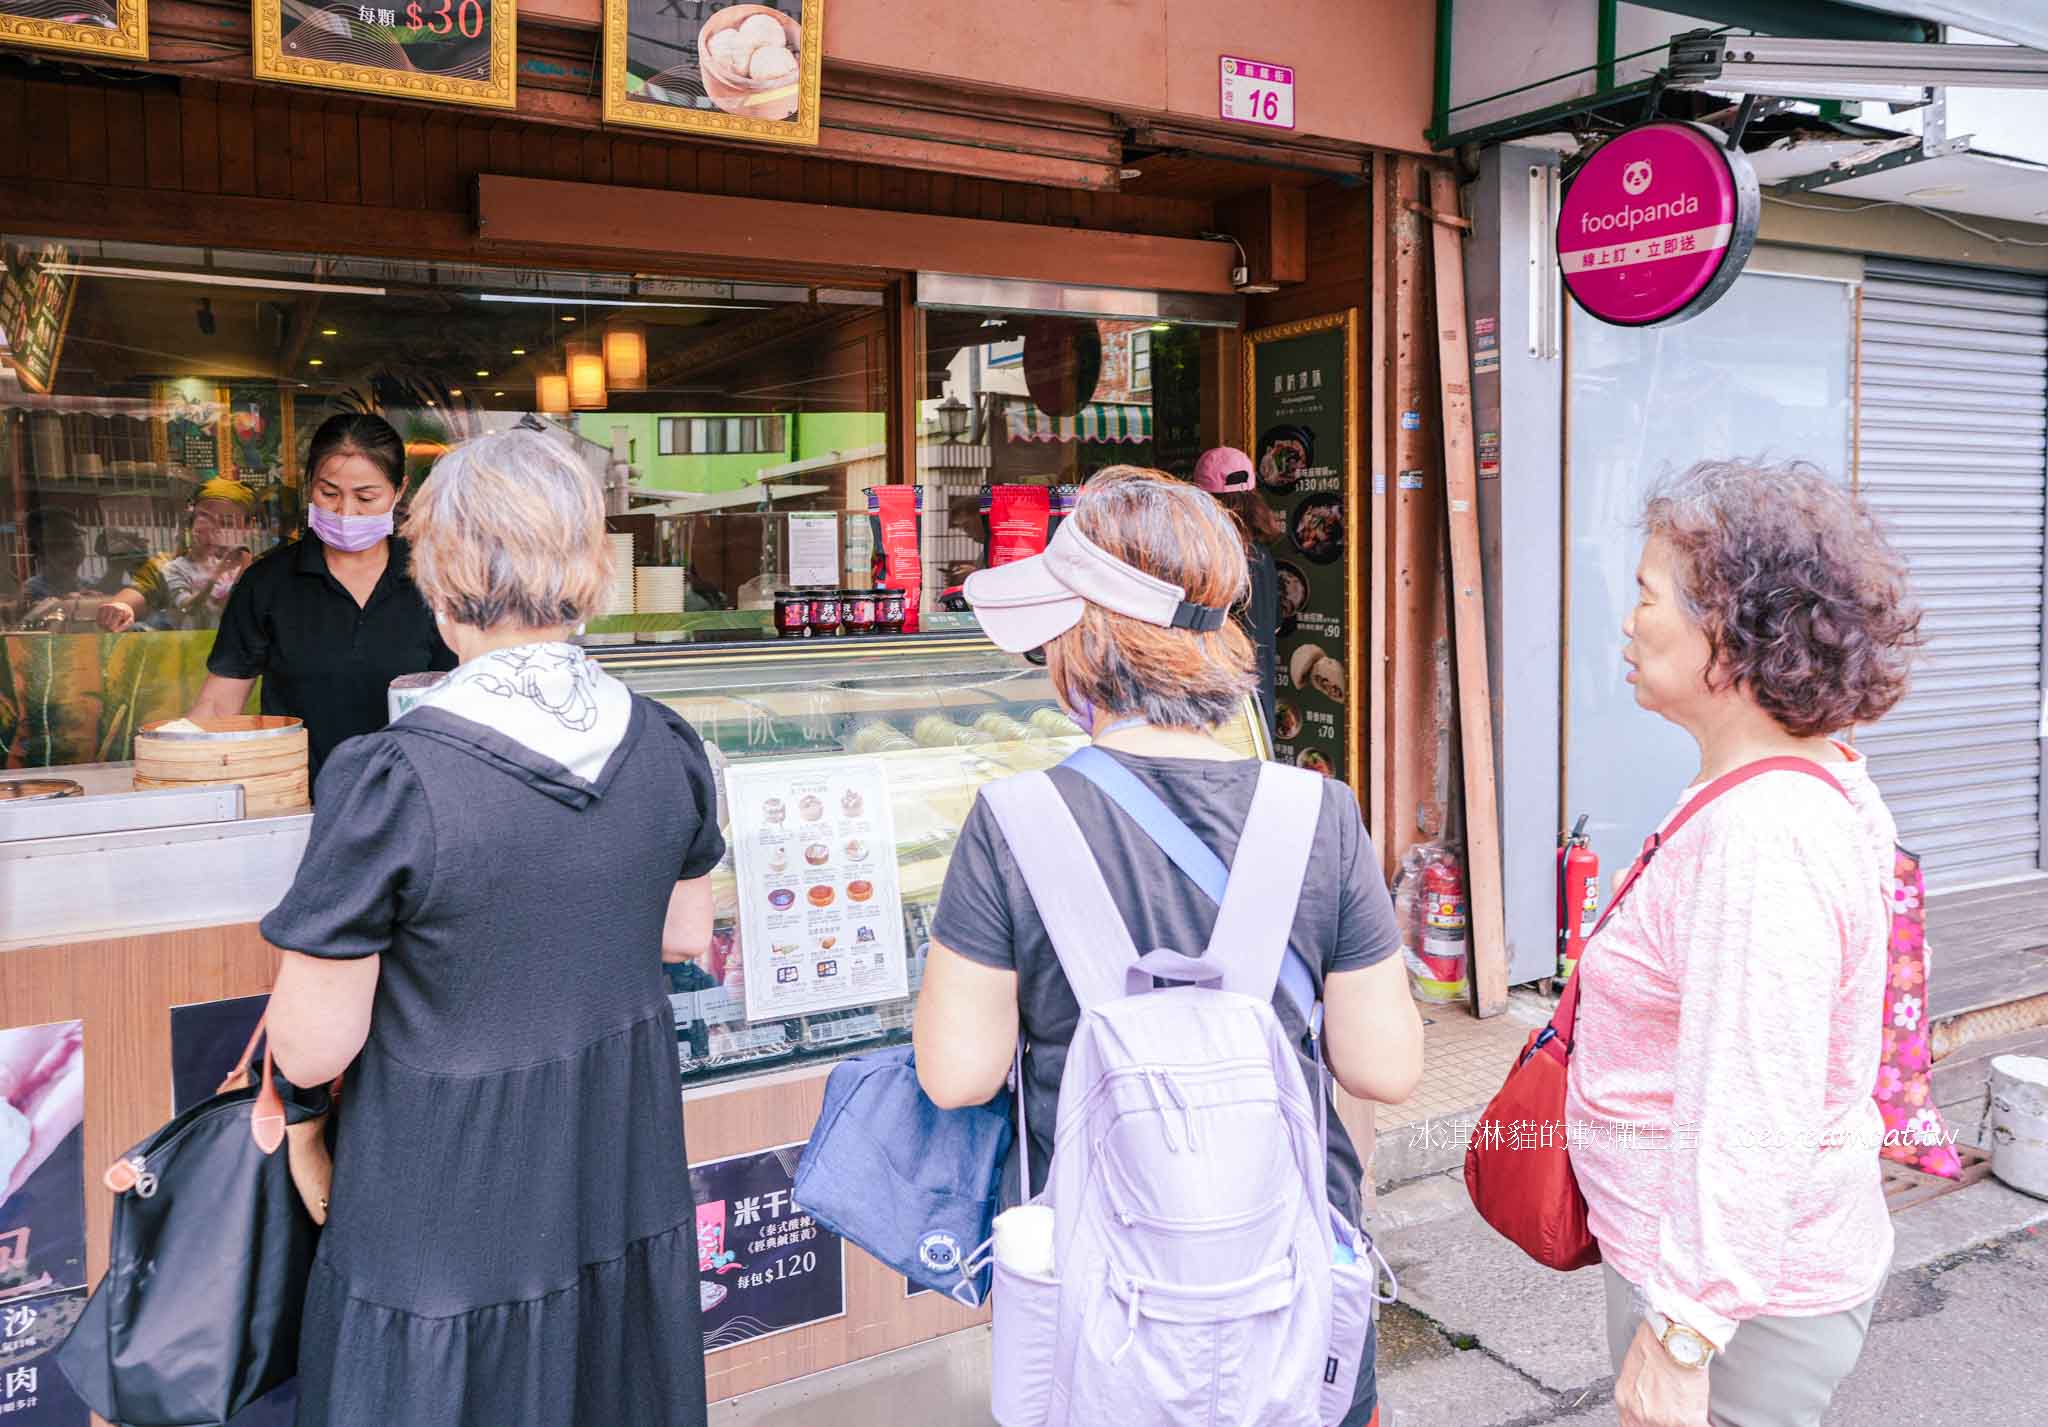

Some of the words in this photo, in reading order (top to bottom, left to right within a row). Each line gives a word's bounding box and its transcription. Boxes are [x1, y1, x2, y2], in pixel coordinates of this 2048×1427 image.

[358, 5, 396, 28] 每顆
[405, 0, 484, 39] $30
[1249, 89, 1279, 121] 16
[1581, 192, 1699, 234] foodpanda
[1317, 724, 1335, 740] $70
[734, 1187, 803, 1227] 米干
[3, 1306, 38, 1337] 沙
[0, 1366, 38, 1399] 肉
